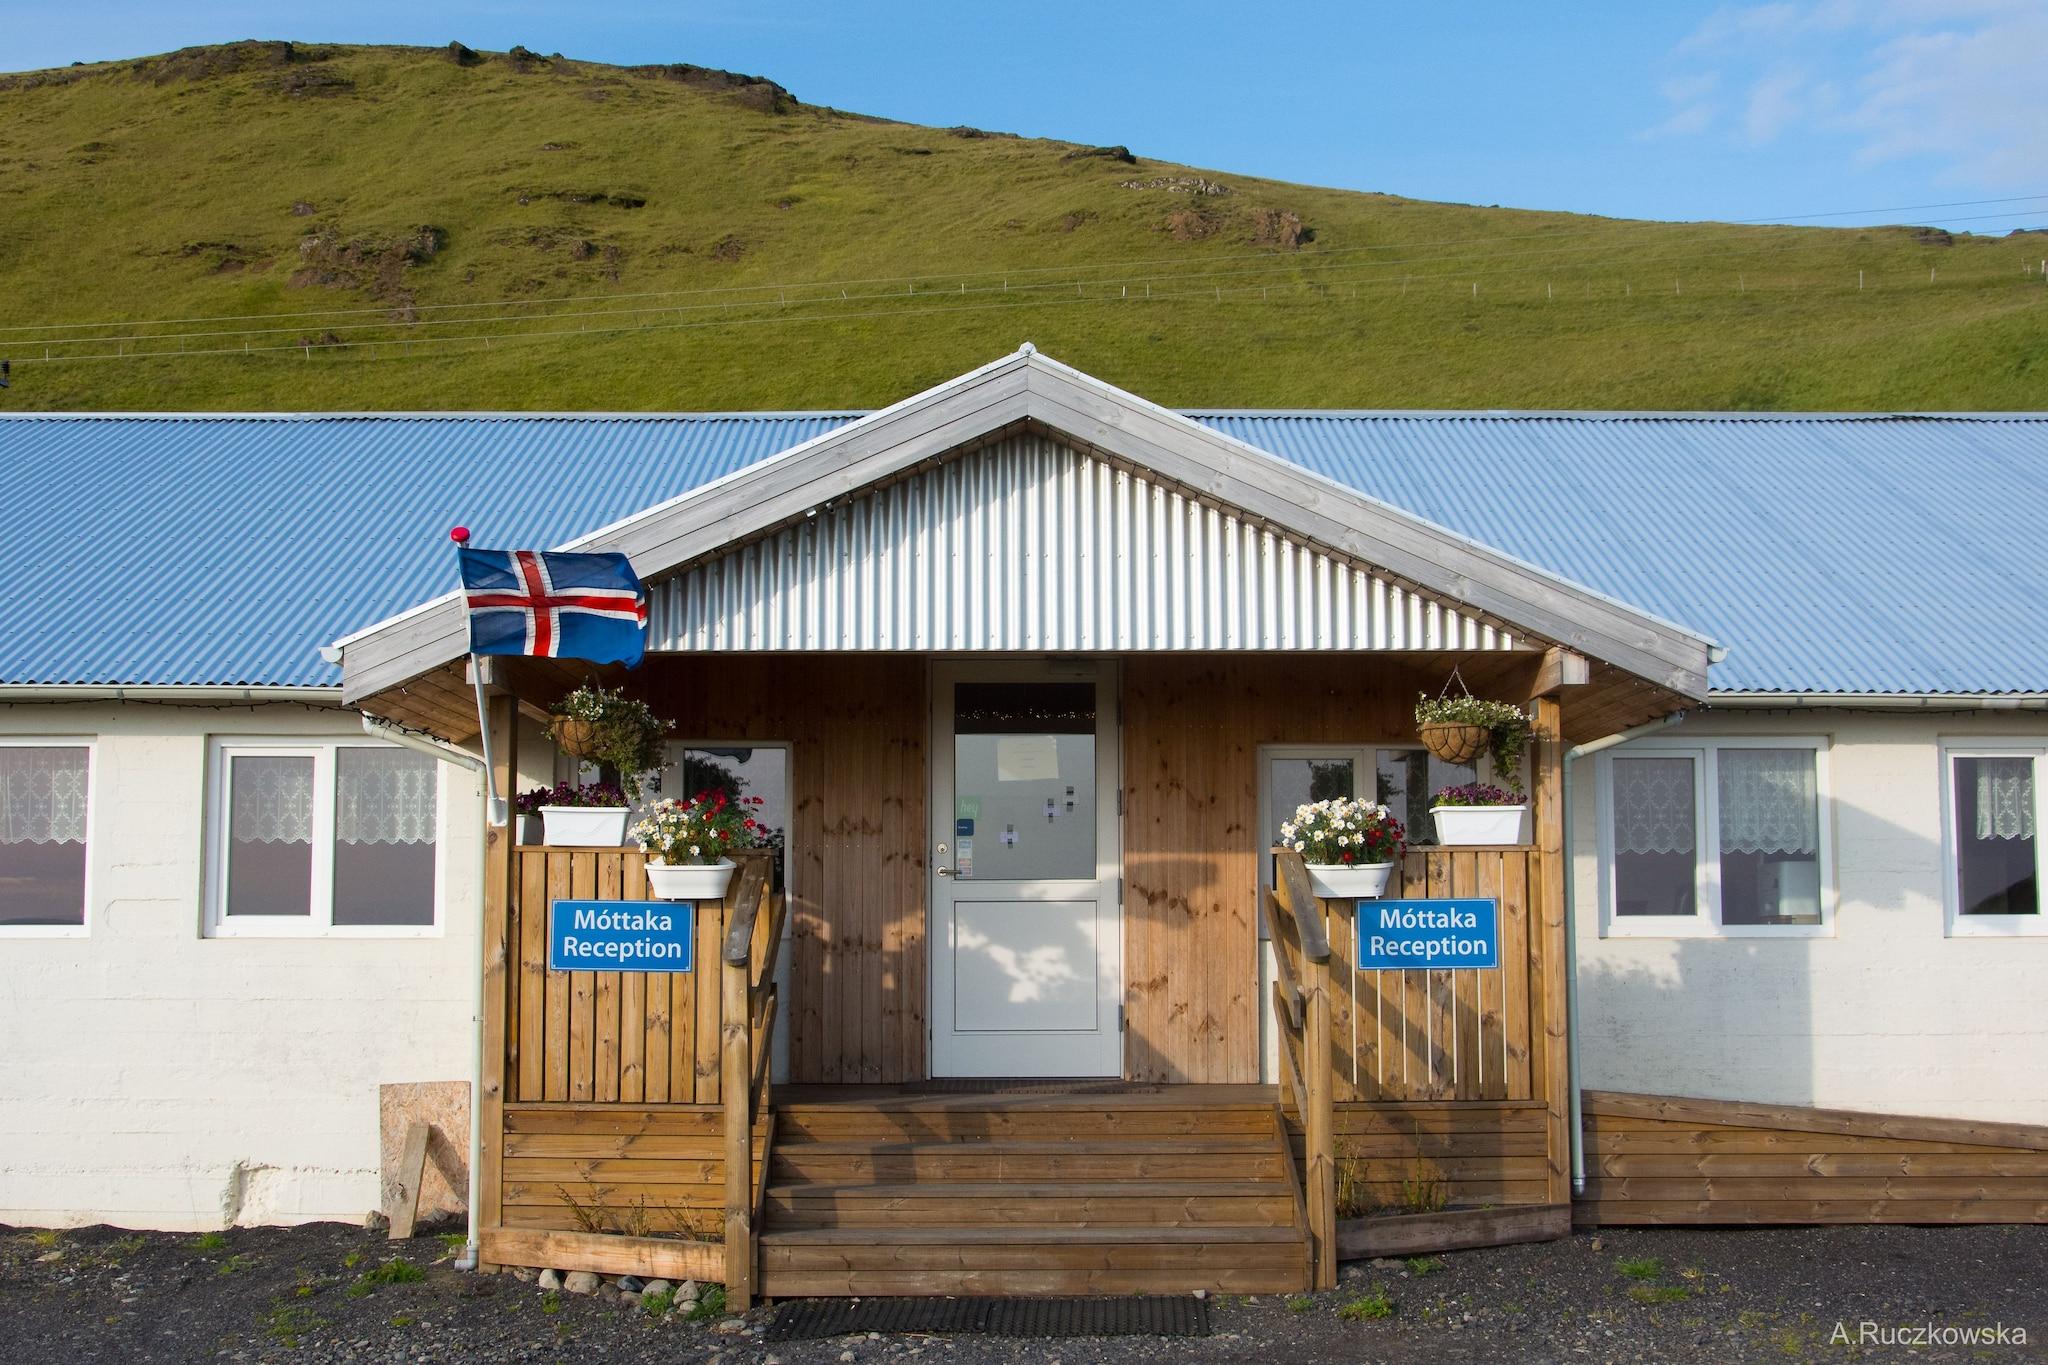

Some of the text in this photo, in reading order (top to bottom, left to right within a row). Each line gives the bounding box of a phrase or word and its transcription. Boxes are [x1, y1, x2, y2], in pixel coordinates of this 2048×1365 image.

[574, 909, 672, 931] Móttaka
[1380, 907, 1477, 929] Móttaka
[563, 936, 681, 962] Reception
[1370, 935, 1487, 960] Reception
